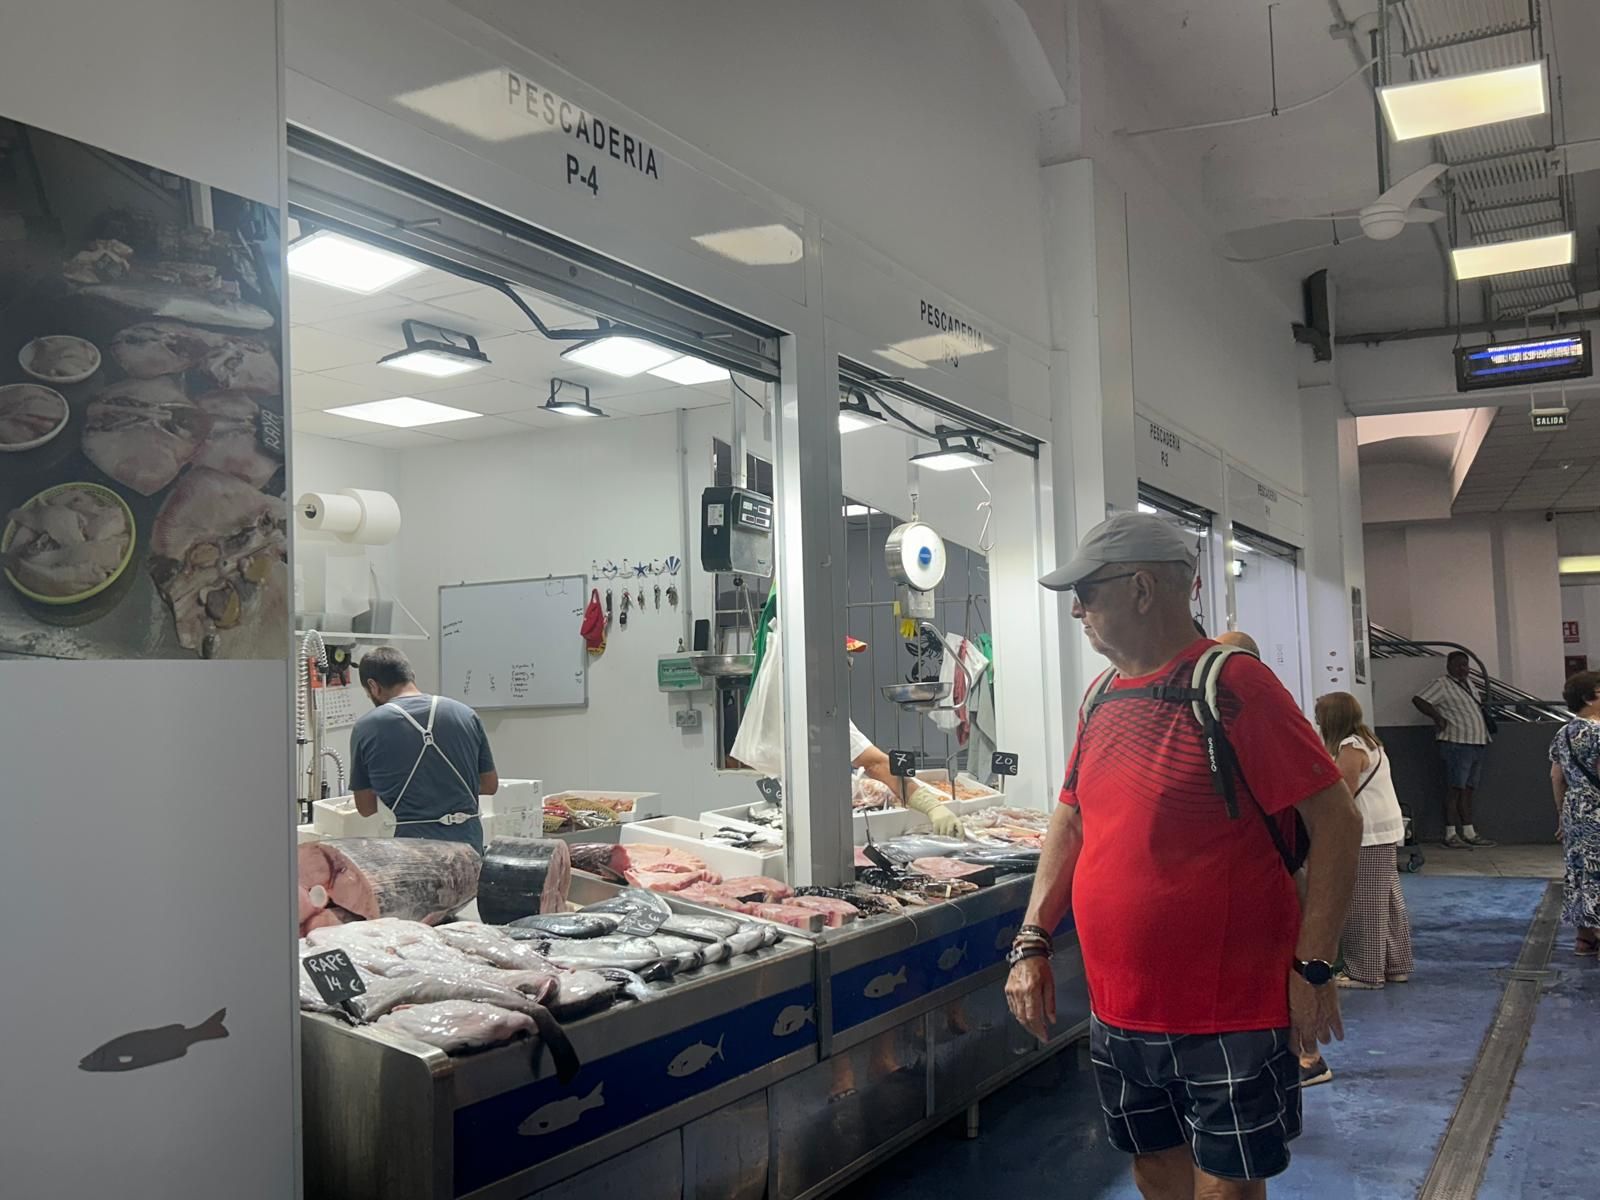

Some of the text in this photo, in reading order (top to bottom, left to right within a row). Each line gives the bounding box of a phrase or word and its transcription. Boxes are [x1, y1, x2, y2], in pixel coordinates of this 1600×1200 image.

[508, 72, 658, 180] PESCADERIA
[566, 153, 599, 196] P-4
[920, 299, 984, 351] PESCADERIA
[1536, 416, 1564, 425] SALIDA
[1150, 423, 1180, 451] PESCADERIA
[895, 752, 908, 767] 7
[995, 754, 1013, 765] 20
[308, 953, 347, 973] RAPE
[324, 974, 343, 992] 14
